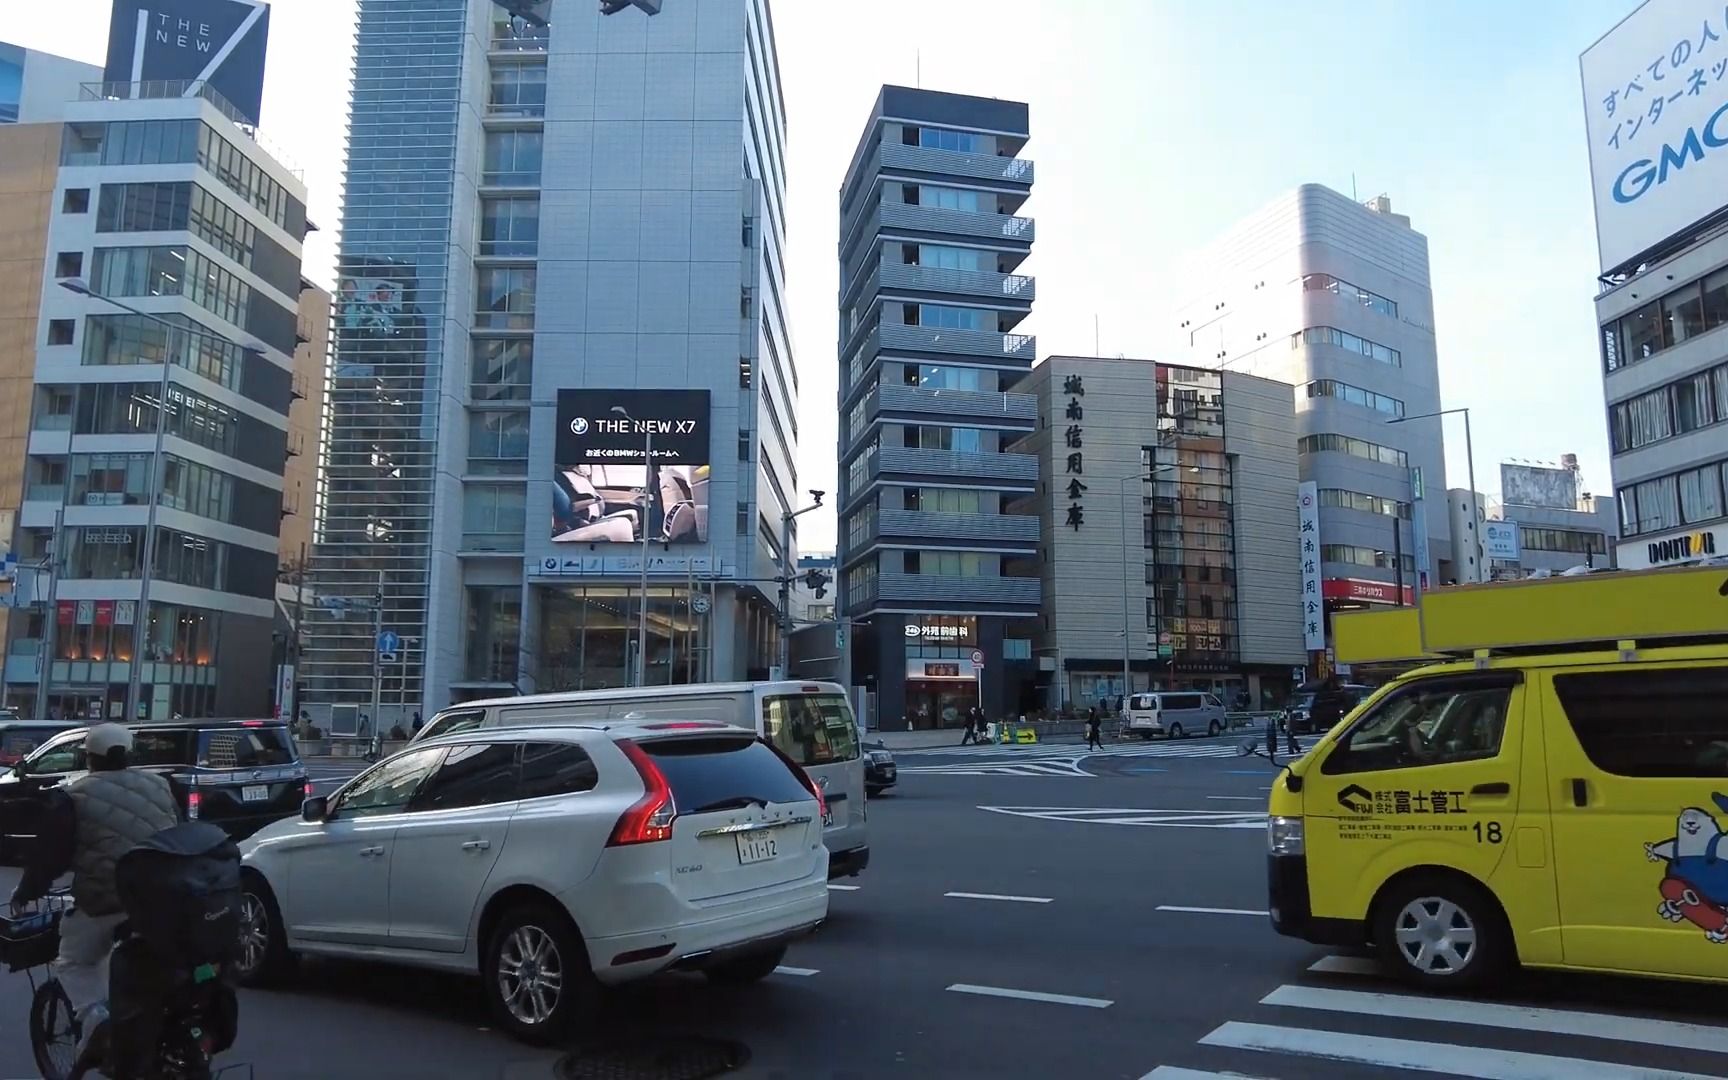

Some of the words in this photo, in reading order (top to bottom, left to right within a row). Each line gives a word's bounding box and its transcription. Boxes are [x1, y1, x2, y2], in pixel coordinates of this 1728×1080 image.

[158, 13, 210, 37] THE
[156, 30, 210, 52] NEW
[1603, 5, 1728, 118] すべての人
[595, 420, 630, 434] THE
[634, 420, 672, 434] NEW
[675, 420, 696, 434] X7
[1063, 374, 1087, 532] 城南信用金庫
[1301, 519, 1319, 638] 城南信用金庫
[1393, 789, 1468, 814] 富士管工
[1472, 821, 1503, 844] 18
